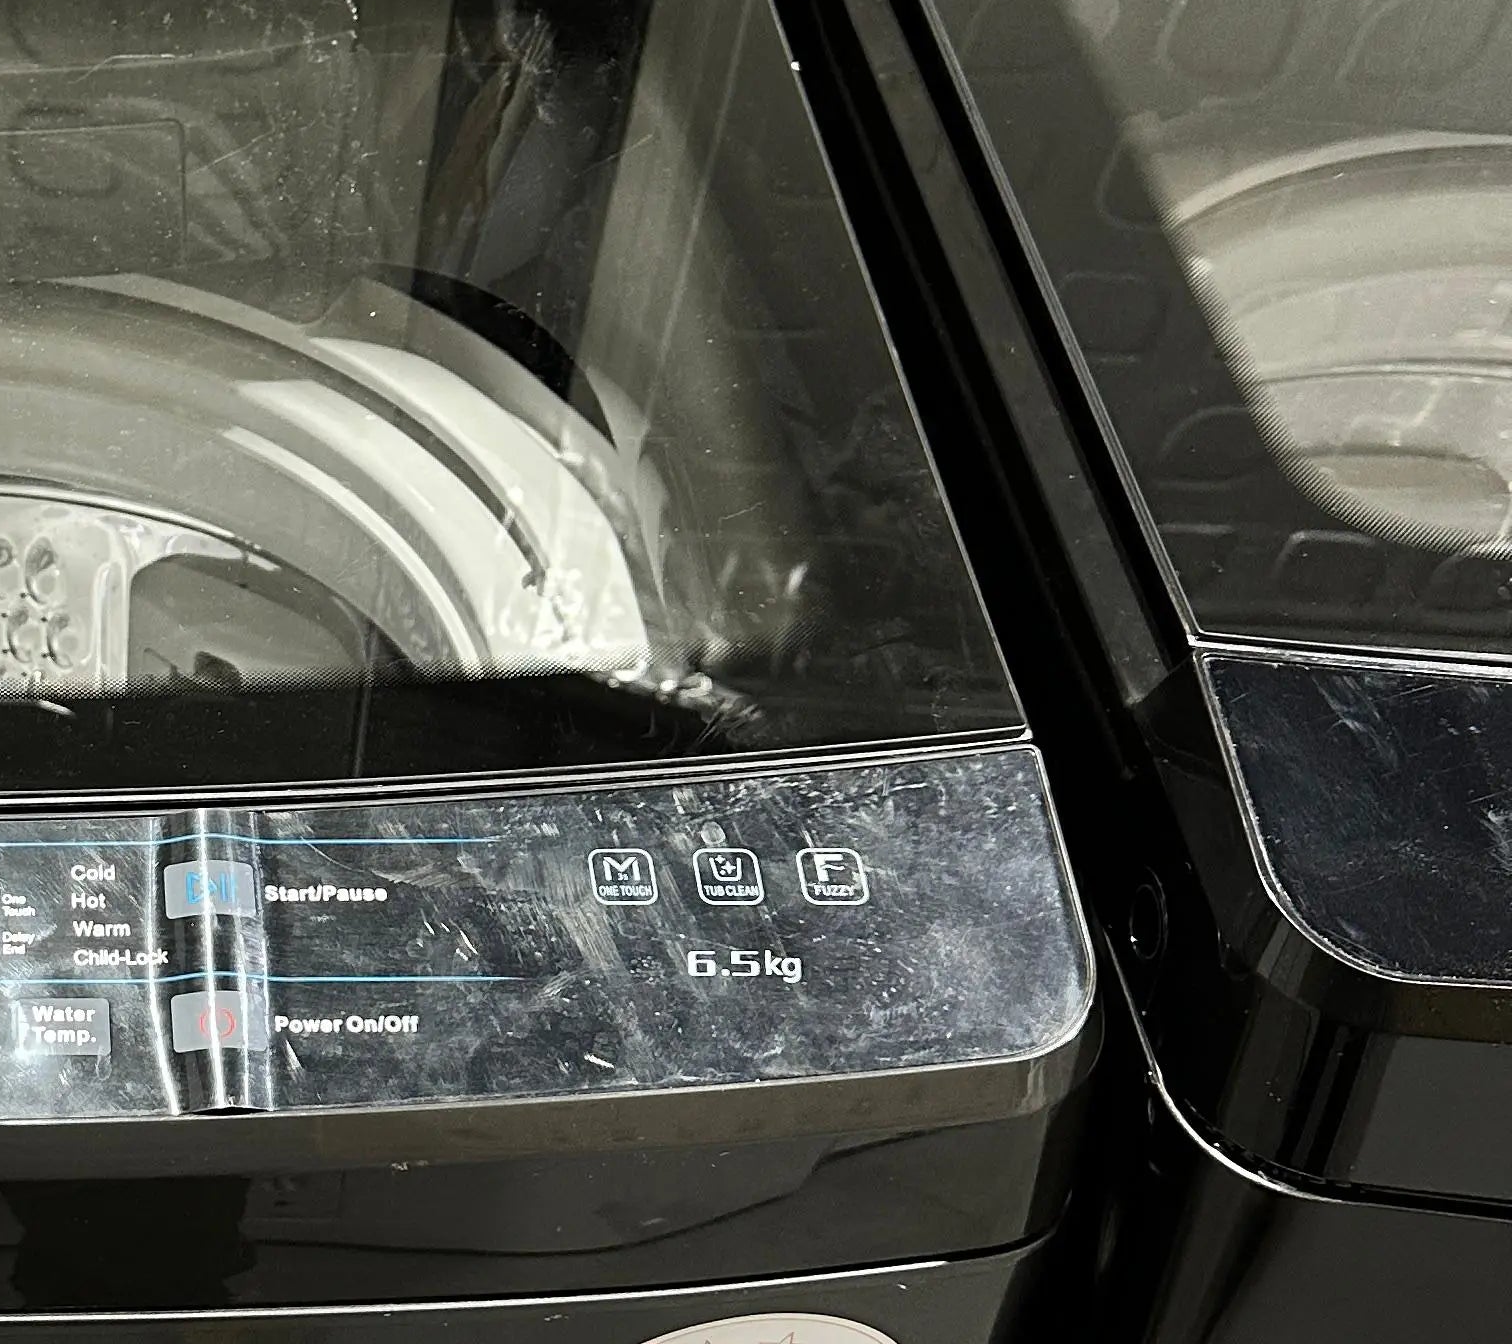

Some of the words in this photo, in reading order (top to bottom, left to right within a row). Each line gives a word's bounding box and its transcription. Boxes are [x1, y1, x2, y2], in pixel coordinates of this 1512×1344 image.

[70, 864, 116, 882] Cold
[1, 893, 27, 905] One
[264, 884, 388, 904] Start/Pause
[598, 885, 620, 898] ONE
[621, 885, 653, 898] TOUCH
[703, 885, 725, 898] TUB
[725, 885, 761, 898] CLEAN
[813, 884, 855, 898] FUZZY
[70, 892, 107, 910] Hot
[2, 905, 36, 917] Touch
[2, 931, 36, 945] Delay
[72, 921, 131, 938] Warm
[2, 943, 26, 955] End
[73, 948, 169, 967] Child-Lock
[688, 949, 802, 984] 6.5kg
[32, 1006, 96, 1023] Water
[274, 1015, 342, 1035] Power
[346, 1013, 419, 1035] On/Off
[32, 1026, 97, 1045] Temp.
